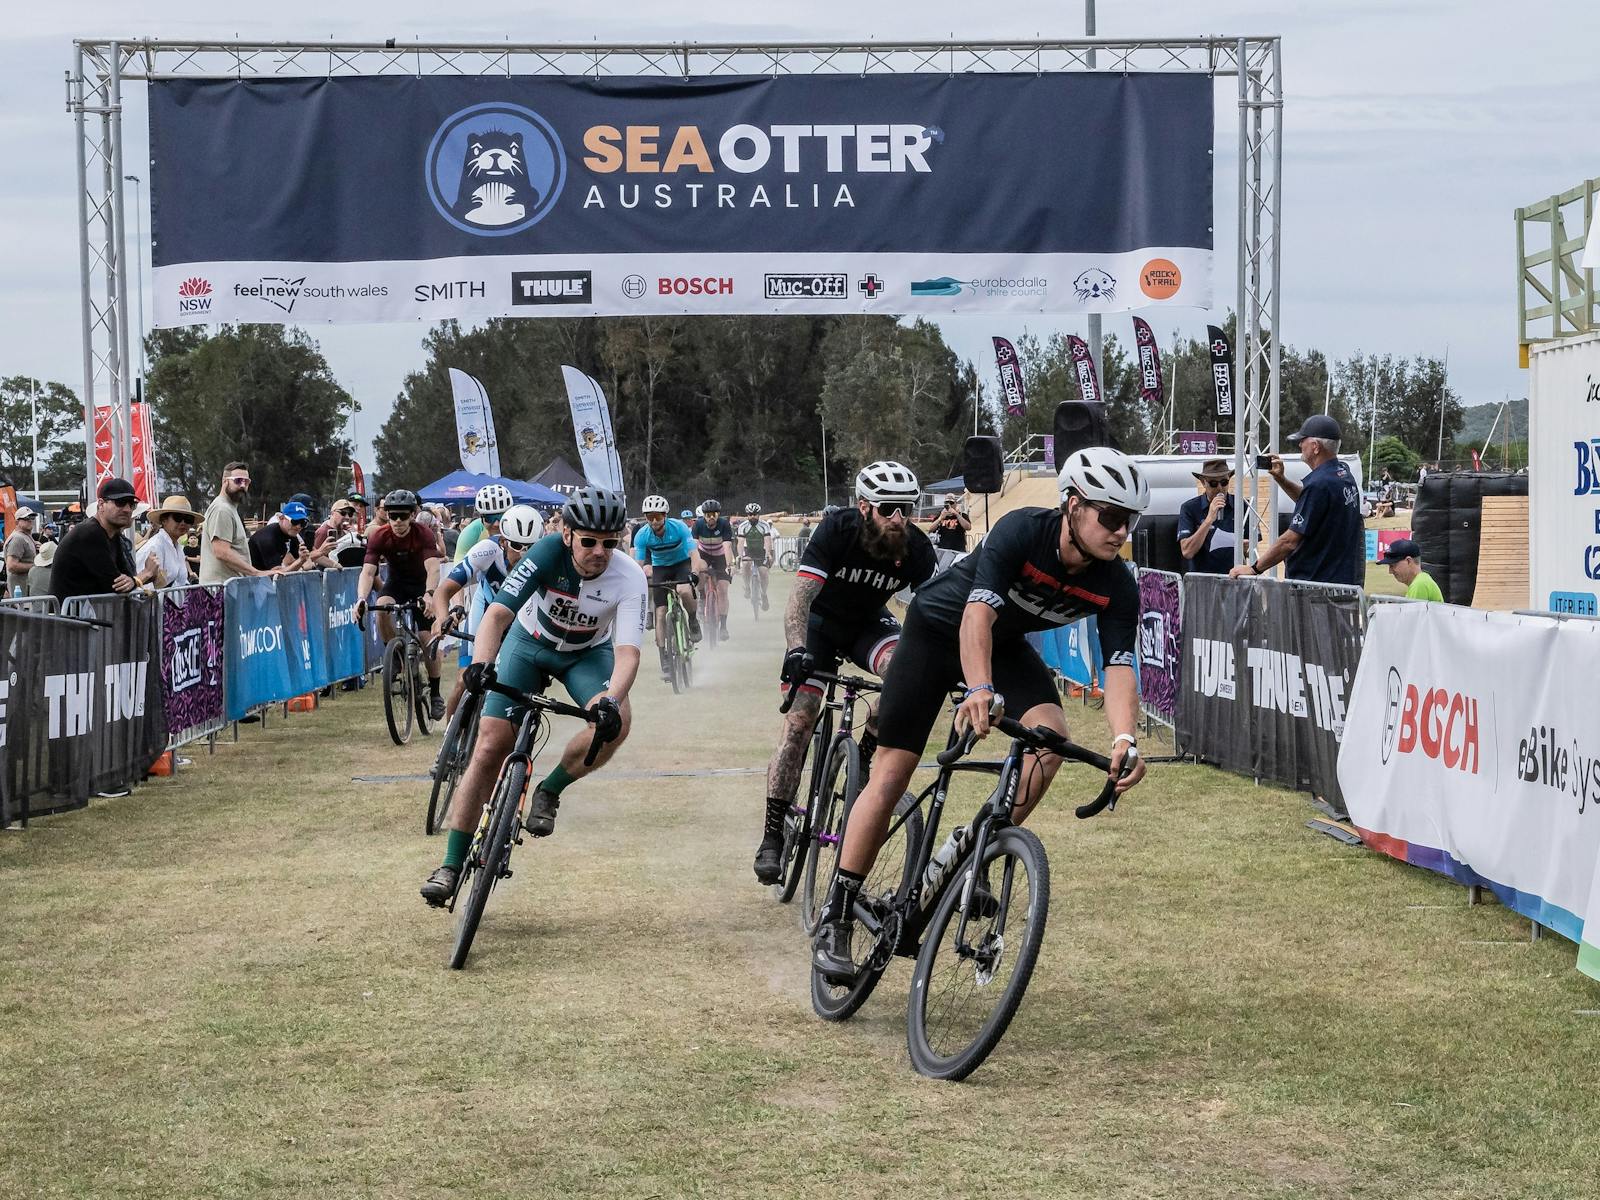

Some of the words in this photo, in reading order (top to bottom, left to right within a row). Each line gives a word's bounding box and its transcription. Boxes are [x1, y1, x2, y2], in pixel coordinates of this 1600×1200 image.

[583, 124, 715, 174] SEA
[718, 123, 932, 174] OTTER
[583, 183, 856, 209] AUSTRALIA
[971, 276, 1047, 289] eurobodalla
[1150, 270, 1177, 278] ROCKY
[1152, 278, 1178, 287] TRAIL
[233, 281, 263, 298] feel
[266, 286, 300, 298] new
[303, 285, 345, 298] south
[347, 284, 388, 298] wales
[415, 281, 486, 302] SMITH
[520, 279, 584, 297] THULE
[658, 277, 734, 295] BOSCH
[769, 277, 845, 296] Muc-Off
[986, 287, 1008, 297] shire
[1010, 287, 1047, 297] council
[179, 298, 212, 311] NSW
[1141, 347, 1156, 389] Muc-Off
[1003, 365, 1020, 405] Muc-Off
[1078, 361, 1094, 399] Muc-Off
[1214, 364, 1232, 414] Muc-Off
[503, 557, 539, 598] BATCH
[548, 604, 599, 626] BATCH
[1397, 683, 1480, 776] BOSCH
[1518, 725, 1568, 792] eBike
